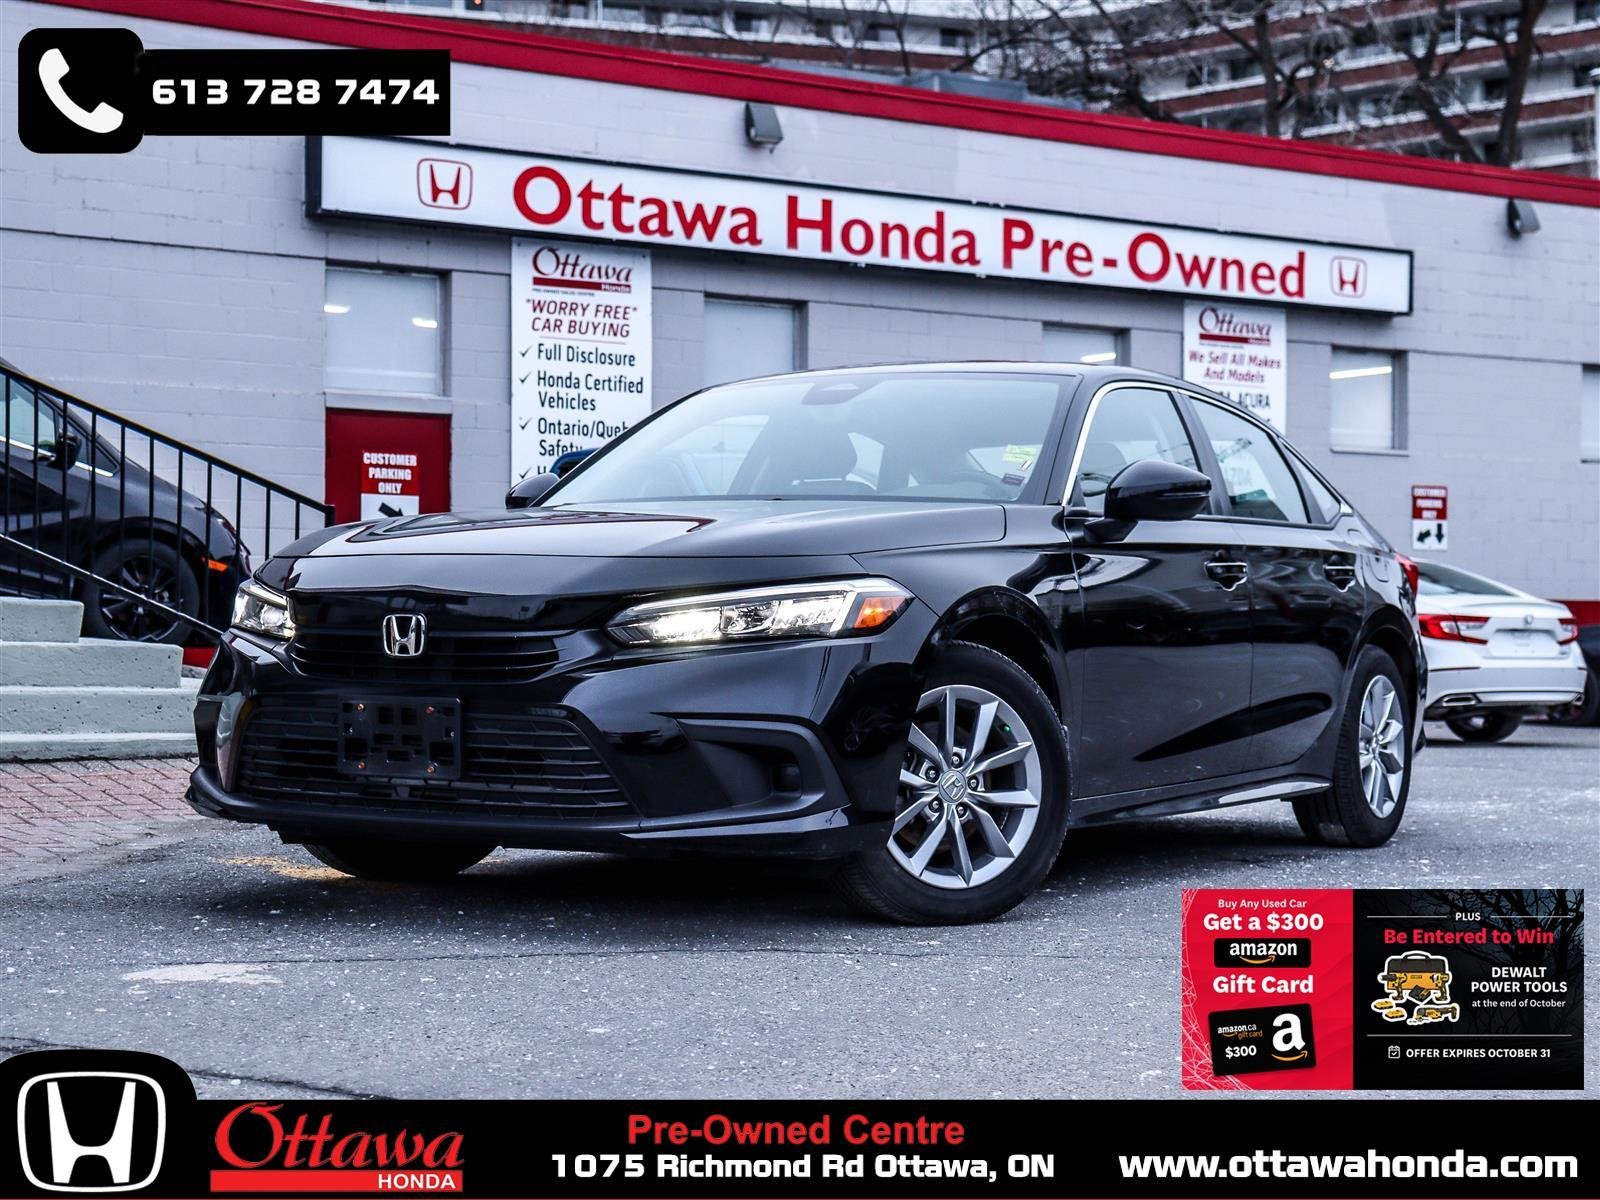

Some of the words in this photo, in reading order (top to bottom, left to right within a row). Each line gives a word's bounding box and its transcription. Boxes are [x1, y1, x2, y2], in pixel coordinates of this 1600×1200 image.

[513, 165, 762, 247] Ottawa
[786, 195, 981, 267] Honda
[1002, 217, 1306, 299] Pre-Owned
[532, 246, 633, 282] Ottawa
[526, 299, 590, 316] "WORRY
[595, 304, 638, 321] FREE"
[1199, 305, 1272, 336] Ottawa
[532, 317, 562, 333] CAR
[568, 320, 630, 338] BUYING
[538, 343, 562, 362] Full
[567, 346, 636, 367] Disclosure
[1189, 350, 1205, 362] We
[1209, 352, 1228, 365] Sell
[1231, 354, 1246, 366] All
[1248, 355, 1281, 369] Makes
[538, 370, 580, 390] Honda
[585, 374, 644, 394] Certified
[1204, 368, 1226, 381] And
[1228, 370, 1265, 384] Models
[538, 392, 596, 411] Vehicles
[363, 452, 417, 466] CUSTOMER
[368, 467, 412, 480] PARKING
[378, 482, 402, 494] ONLY
